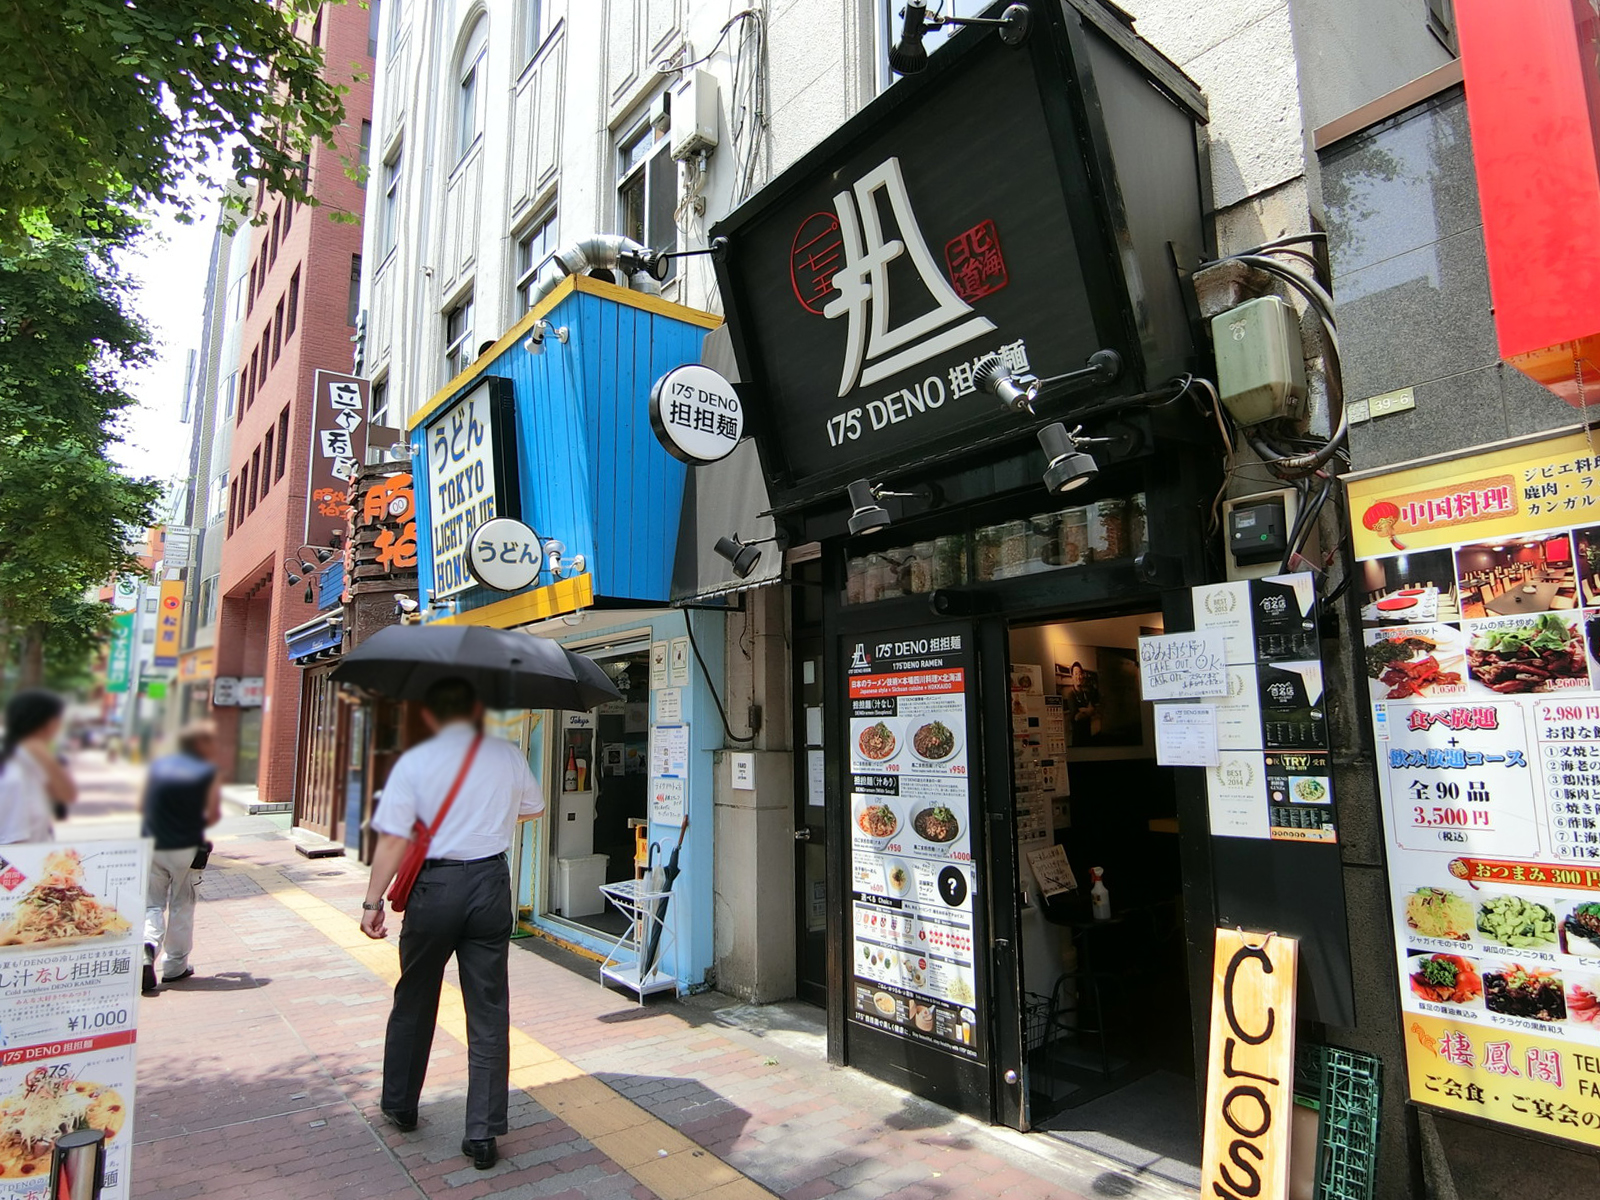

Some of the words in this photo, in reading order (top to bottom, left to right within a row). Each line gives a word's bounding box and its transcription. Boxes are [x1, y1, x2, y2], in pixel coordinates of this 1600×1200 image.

[866, 376, 946, 431] DENO
[948, 339, 1030, 400] 担麺
[698, 389, 739, 413] DENO
[1375, 394, 1409, 411] 39-6
[669, 400, 738, 441] 担担麺
[434, 401, 484, 474] うどん
[438, 459, 484, 515] TOKYO
[1402, 486, 1512, 526] 中国料理
[434, 512, 464, 557] LIGHT
[477, 540, 539, 565] うどん
[895, 639, 928, 656] DENO
[1407, 706, 1500, 731] 食べ放題
[1389, 748, 1527, 769] 飲み放題コース
[1476, 863, 1546, 882] おつまみ
[1408, 935, 1474, 951] ジャガイモの千切り
[68, 1009, 127, 1032] ¥1,000
[26, 1044, 61, 1060] DENO
